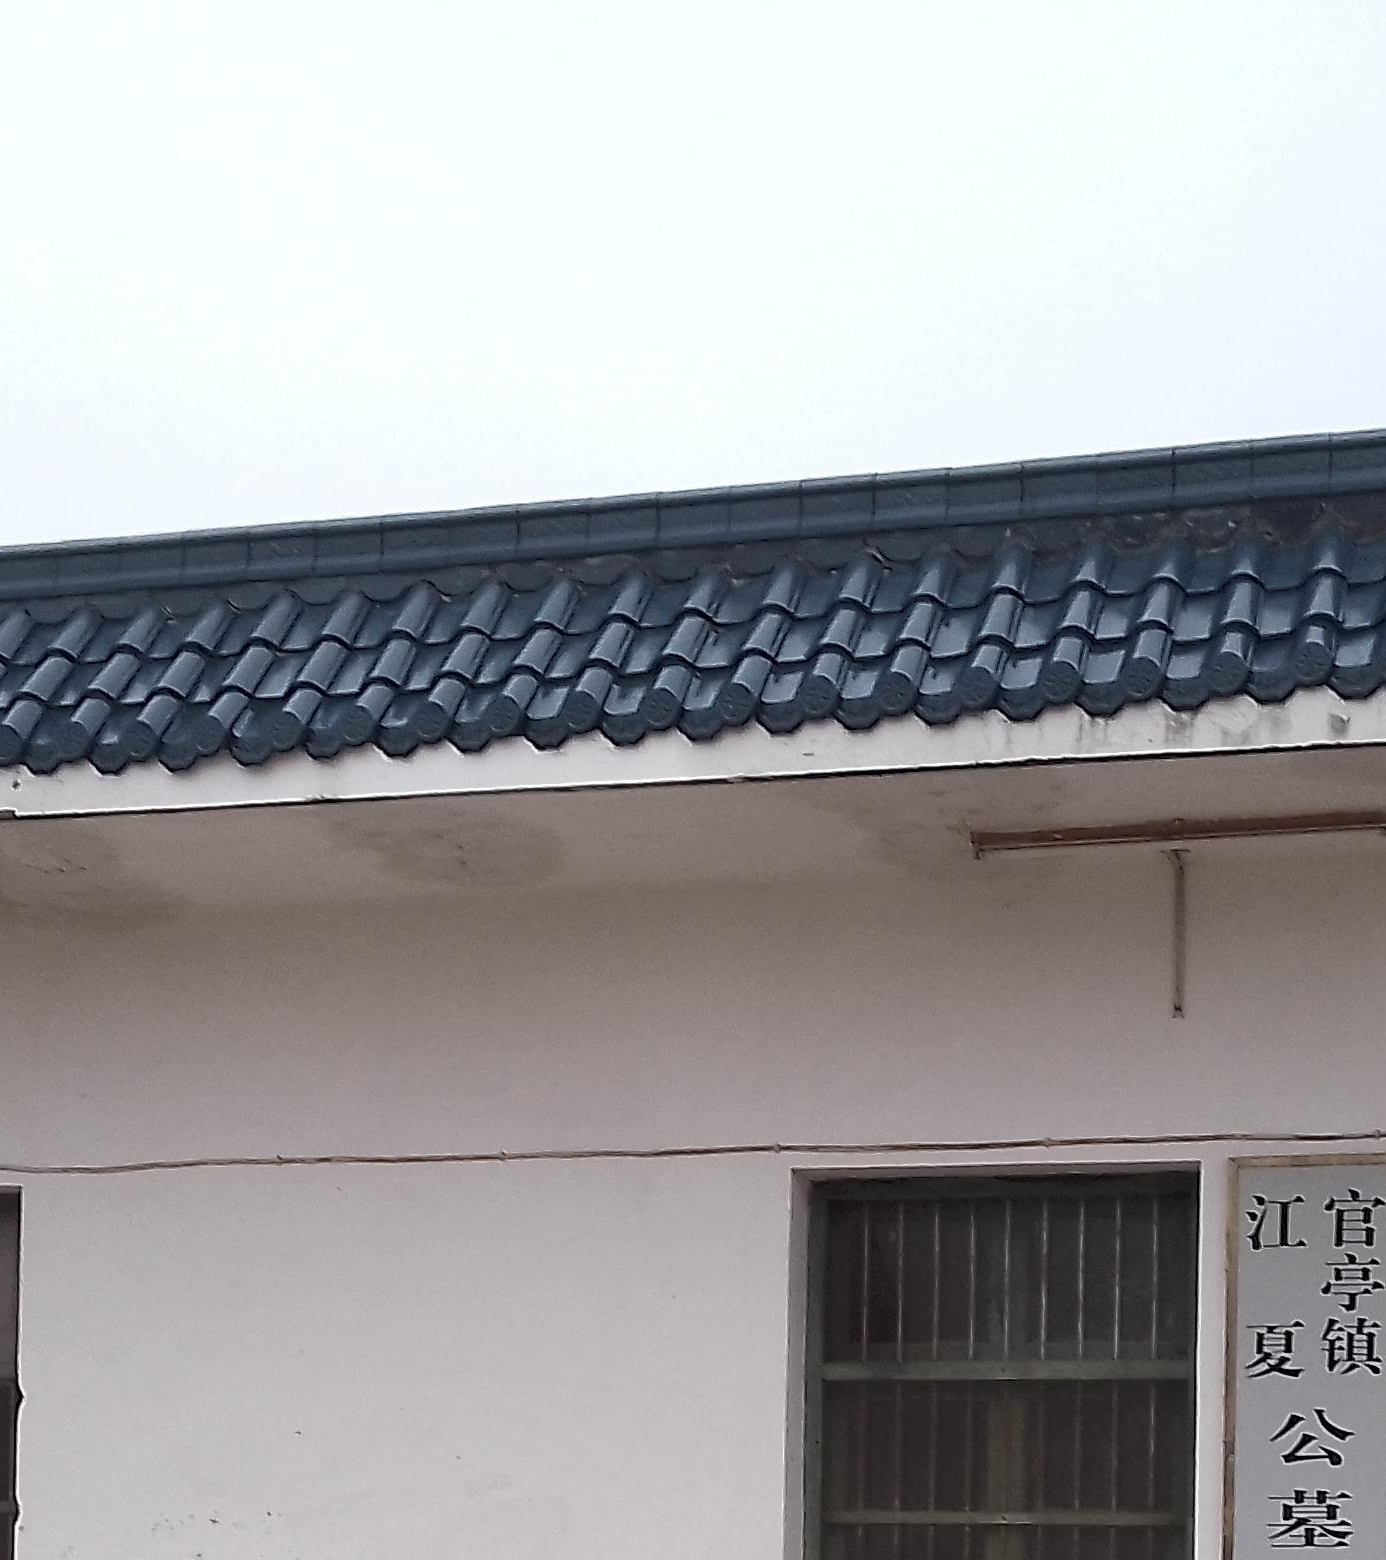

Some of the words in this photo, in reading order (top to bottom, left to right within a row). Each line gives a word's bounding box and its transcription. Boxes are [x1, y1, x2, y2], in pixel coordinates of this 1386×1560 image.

[1244, 1193, 1309, 1379] 江夏
[1320, 1187, 1386, 1376] 官亭镇
